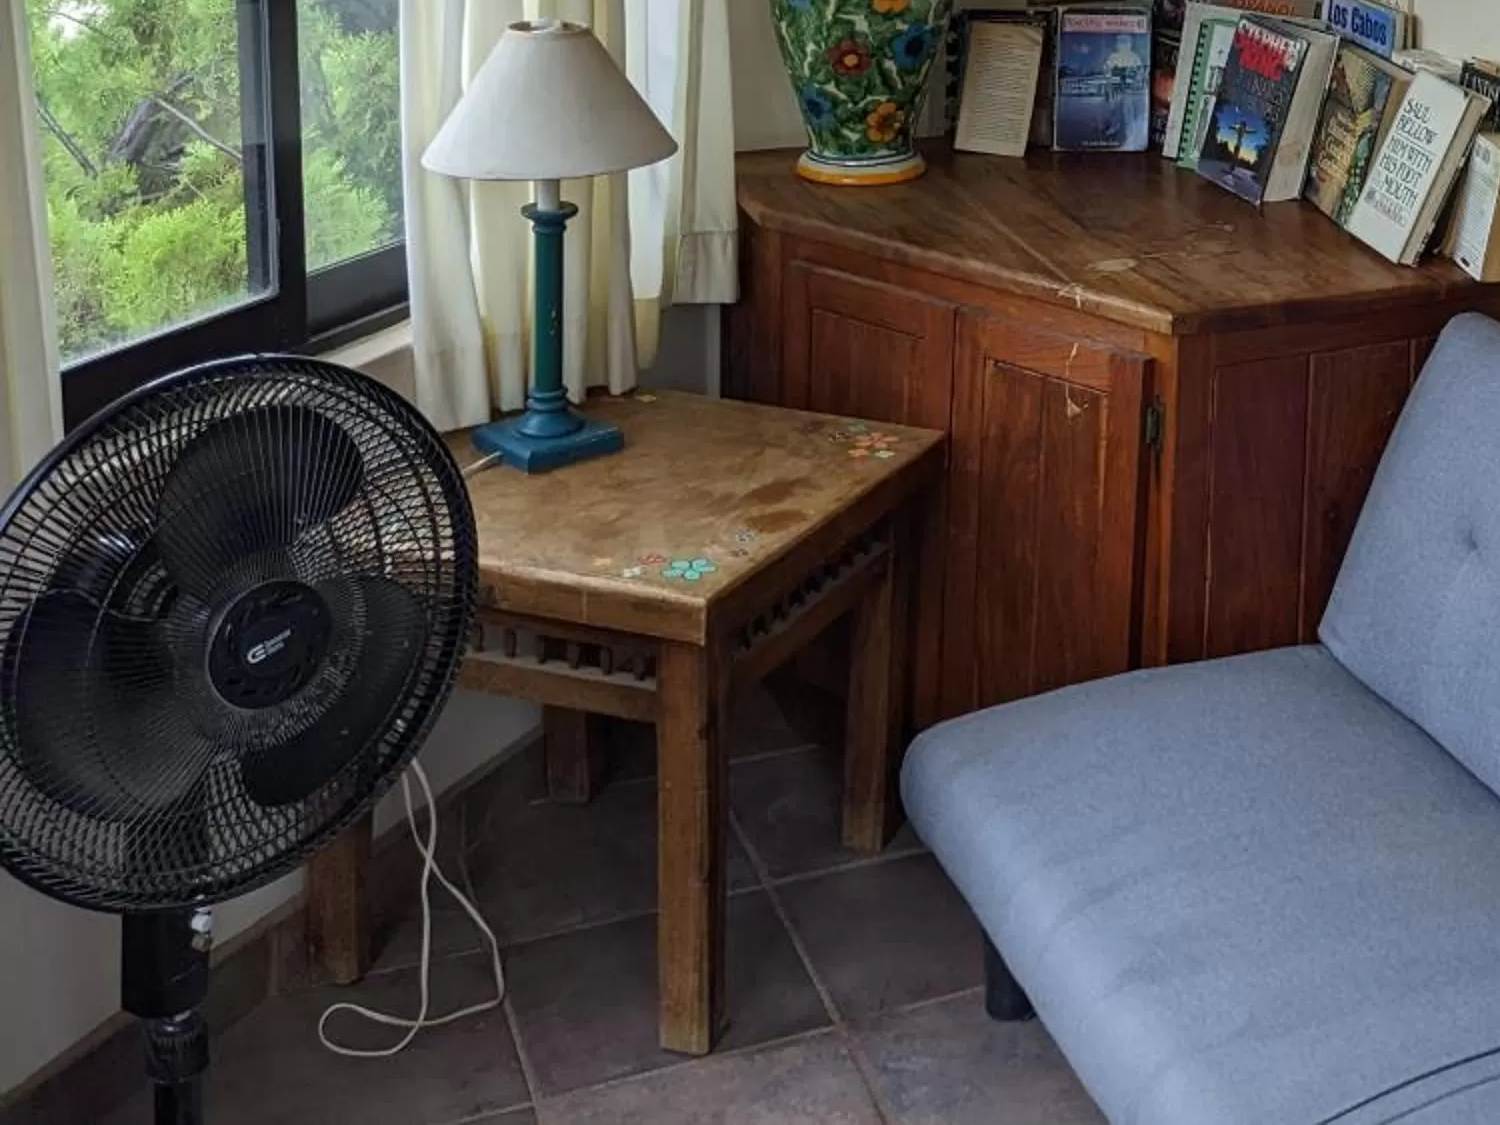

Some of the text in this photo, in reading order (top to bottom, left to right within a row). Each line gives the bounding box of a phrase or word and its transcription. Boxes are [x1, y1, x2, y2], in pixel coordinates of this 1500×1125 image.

[1351, 6, 1387, 45] Cabos
[1404, 97, 1431, 122] SAUL
[1397, 115, 1439, 144] BELLOW
